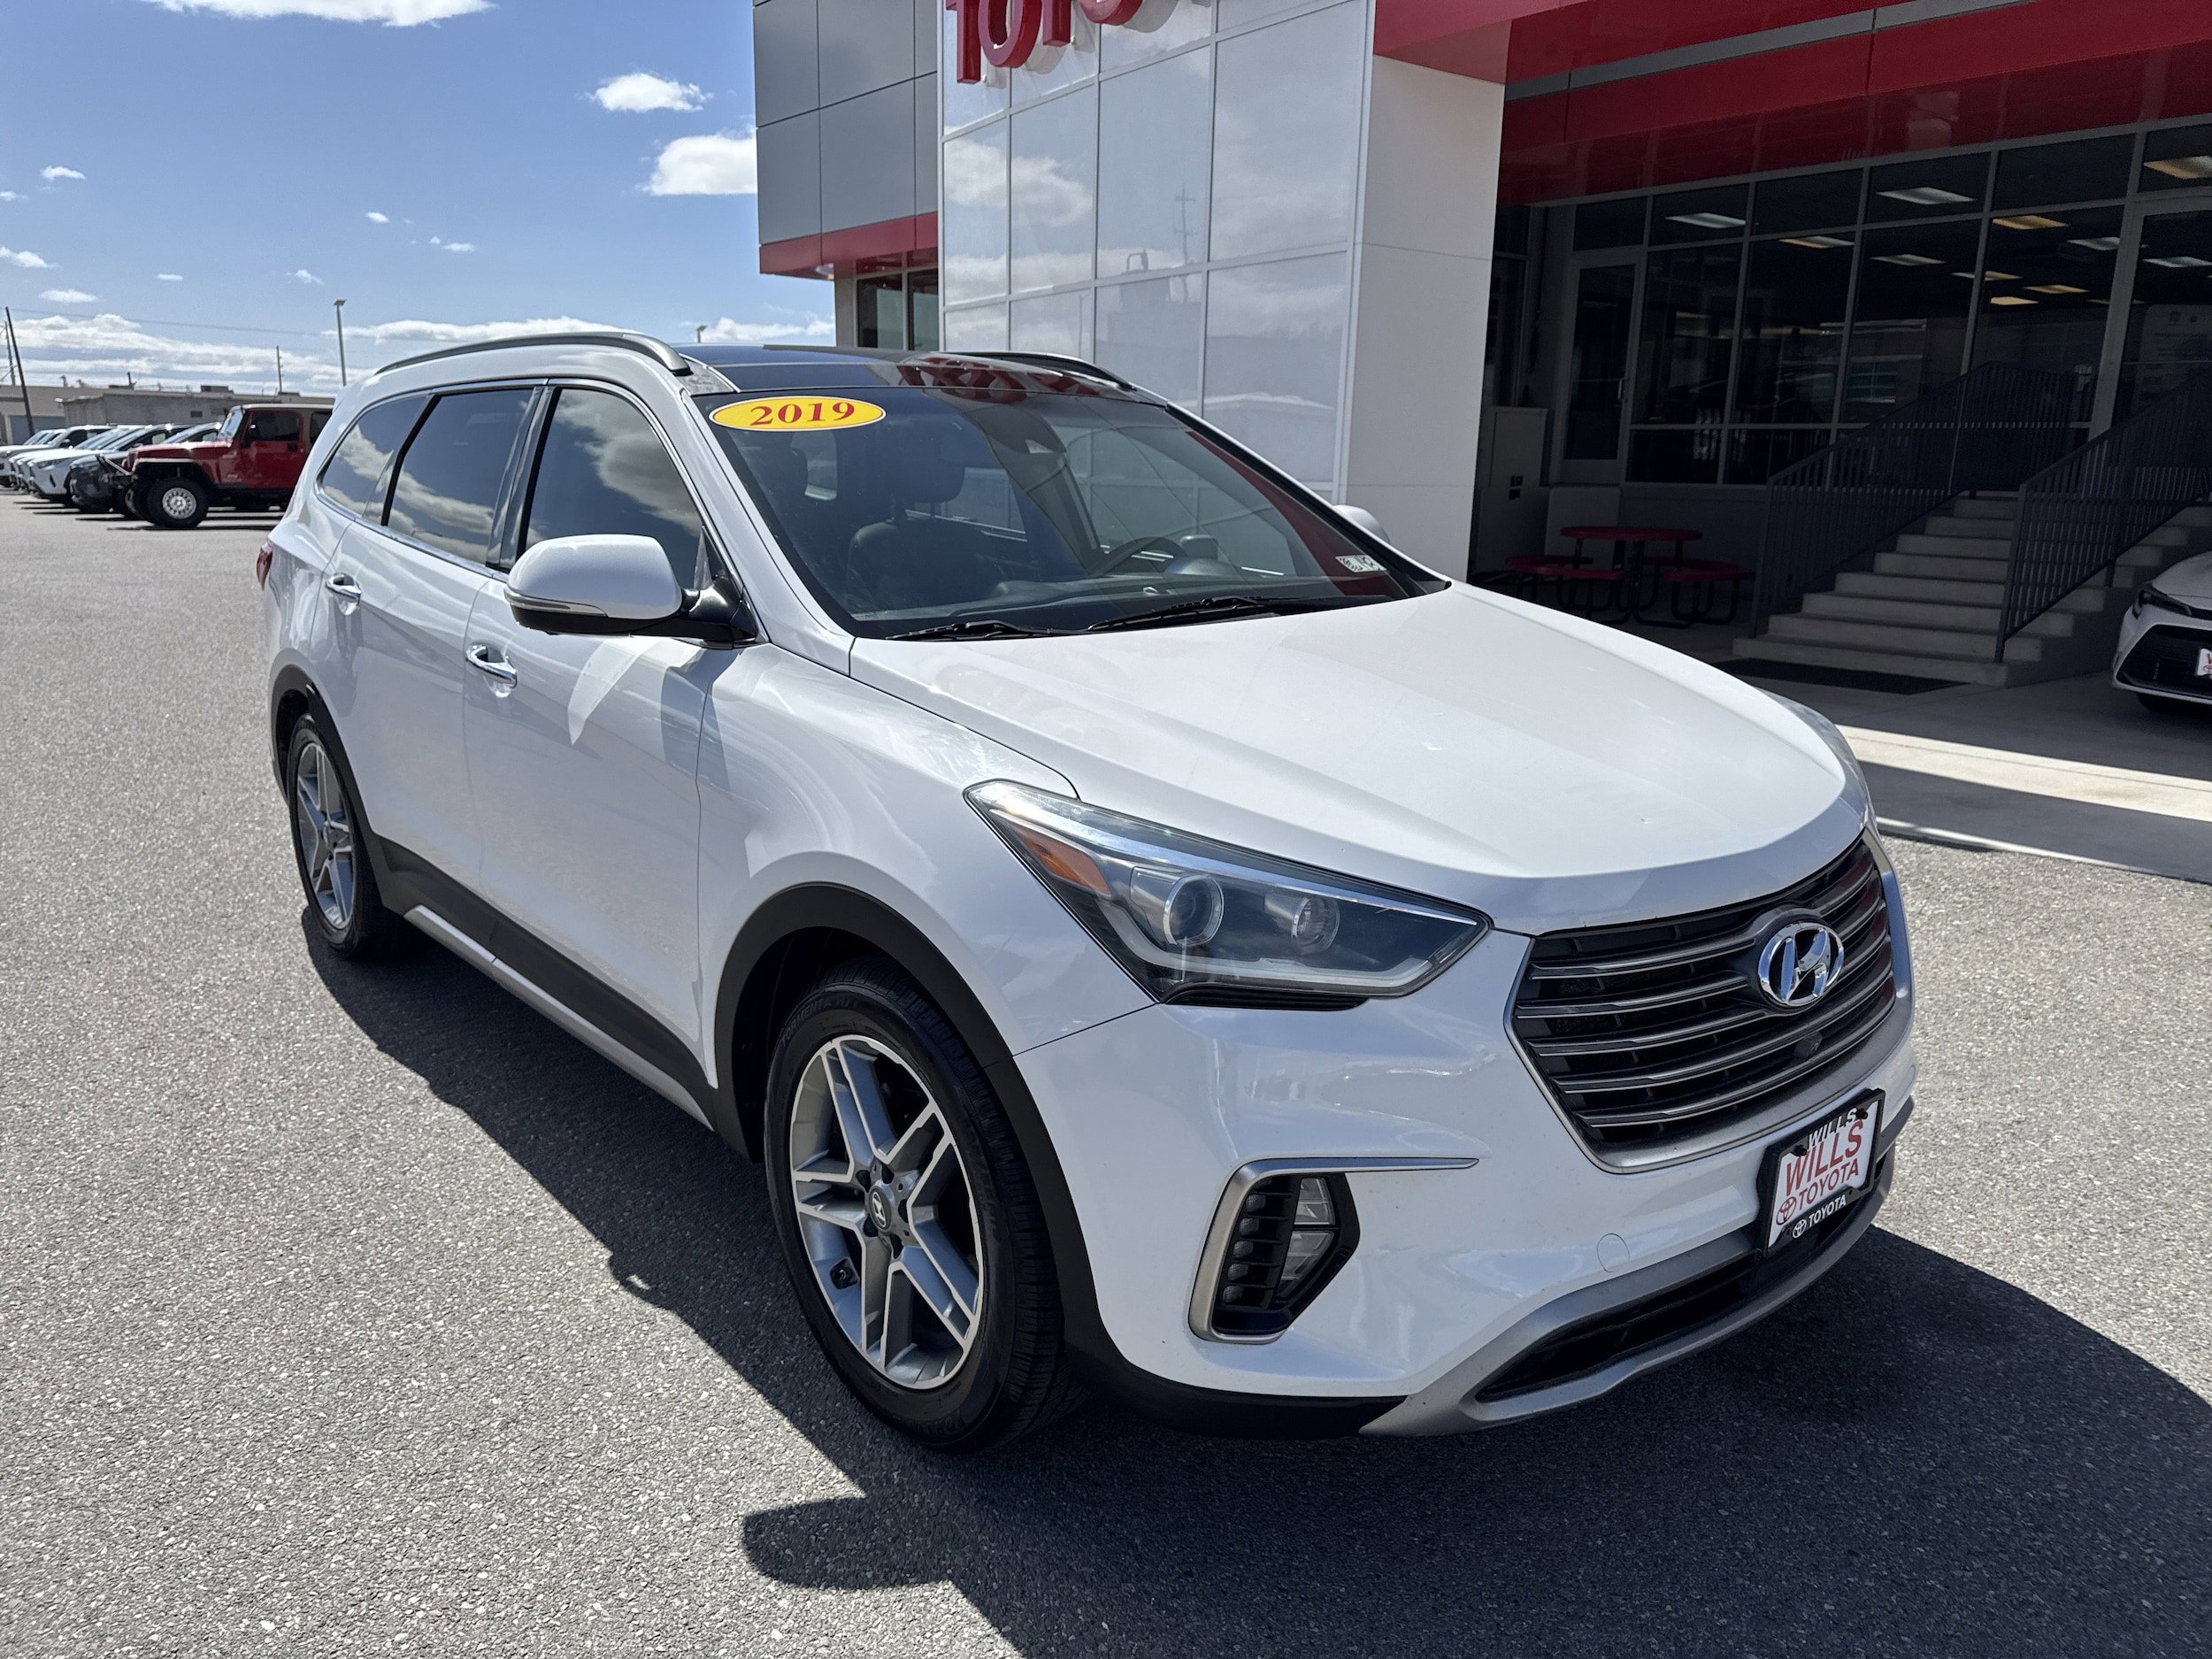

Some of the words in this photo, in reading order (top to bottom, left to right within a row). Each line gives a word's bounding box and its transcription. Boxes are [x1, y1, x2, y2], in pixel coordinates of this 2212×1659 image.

[749, 402, 856, 426] 2019
[1807, 1107, 1857, 1149] WILLS
[1786, 1119, 1863, 1197] WILLS
[1798, 1158, 1859, 1211] TOYOTA
[1807, 1194, 1847, 1227] TOYOTA
